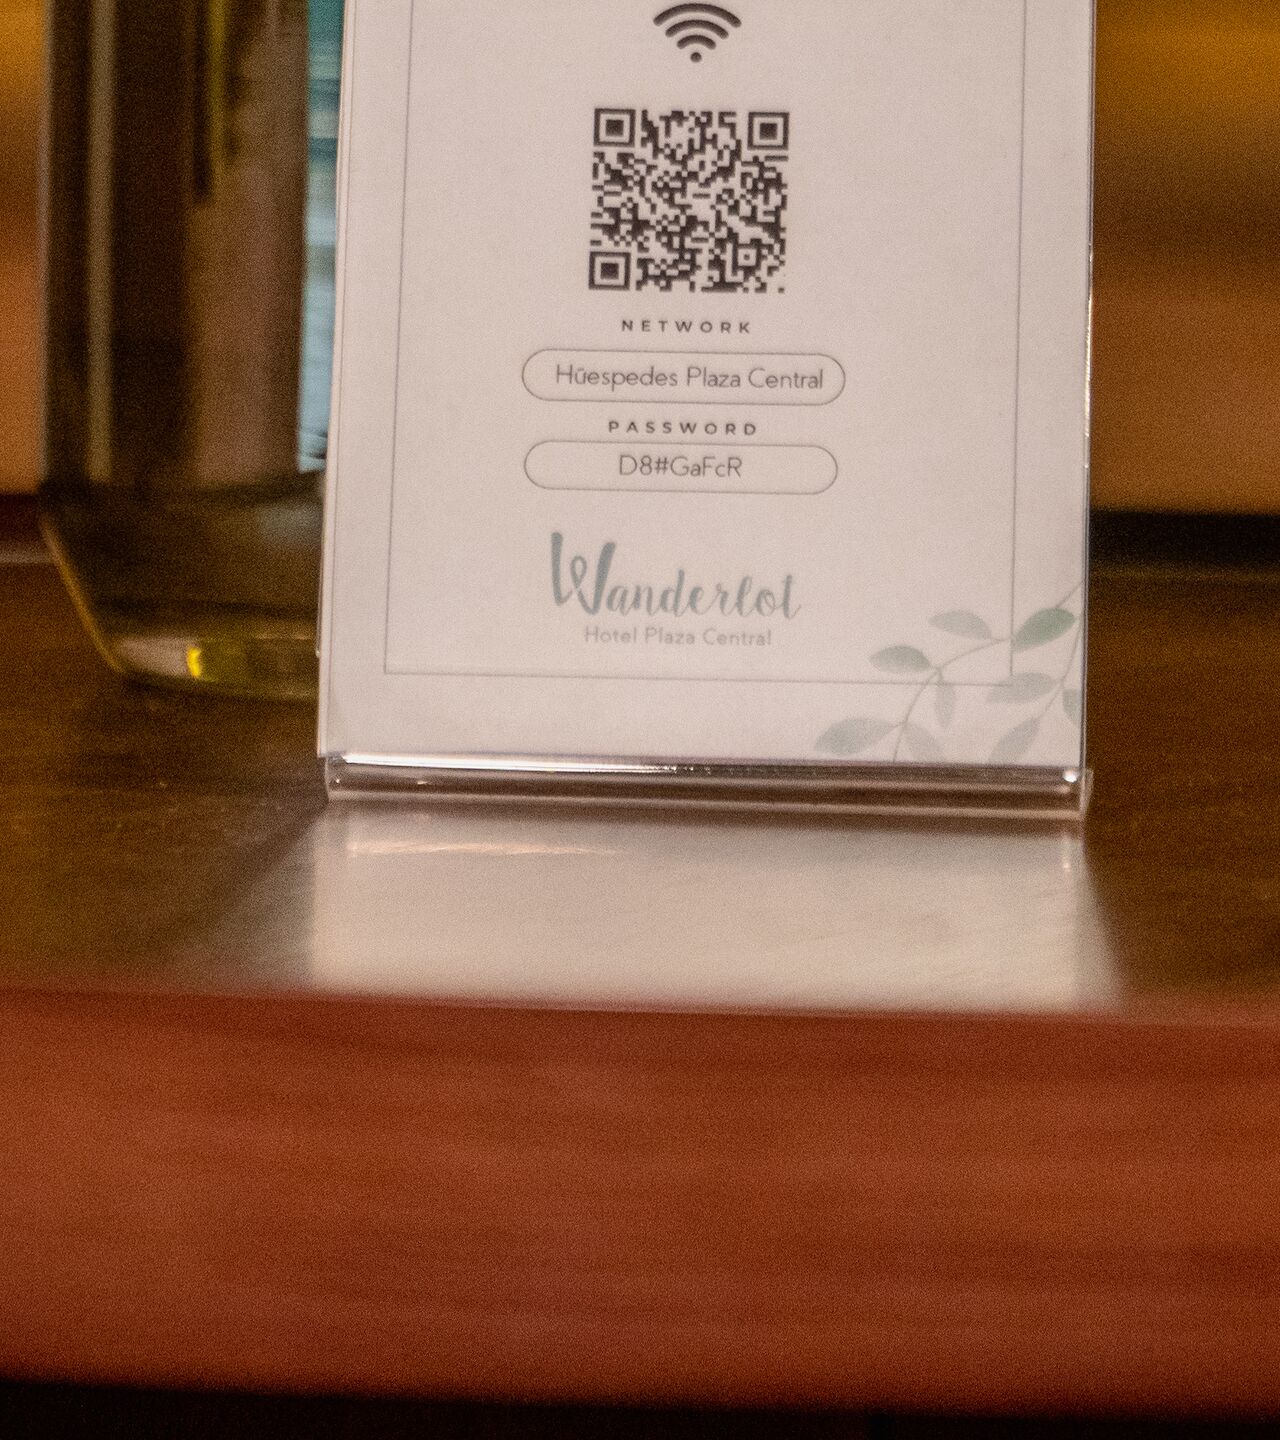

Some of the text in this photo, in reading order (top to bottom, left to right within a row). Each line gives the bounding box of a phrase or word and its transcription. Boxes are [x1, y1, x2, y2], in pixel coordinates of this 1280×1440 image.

[621, 319, 752, 334] NETWORK
[686, 365, 742, 389] Plaza
[747, 367, 824, 390] Central
[608, 420, 758, 436] PASSWORD
[618, 454, 743, 478] D8#GaFcR
[550, 531, 802, 620] Wanderlot
[584, 626, 772, 647] Hotel Plaza Central
